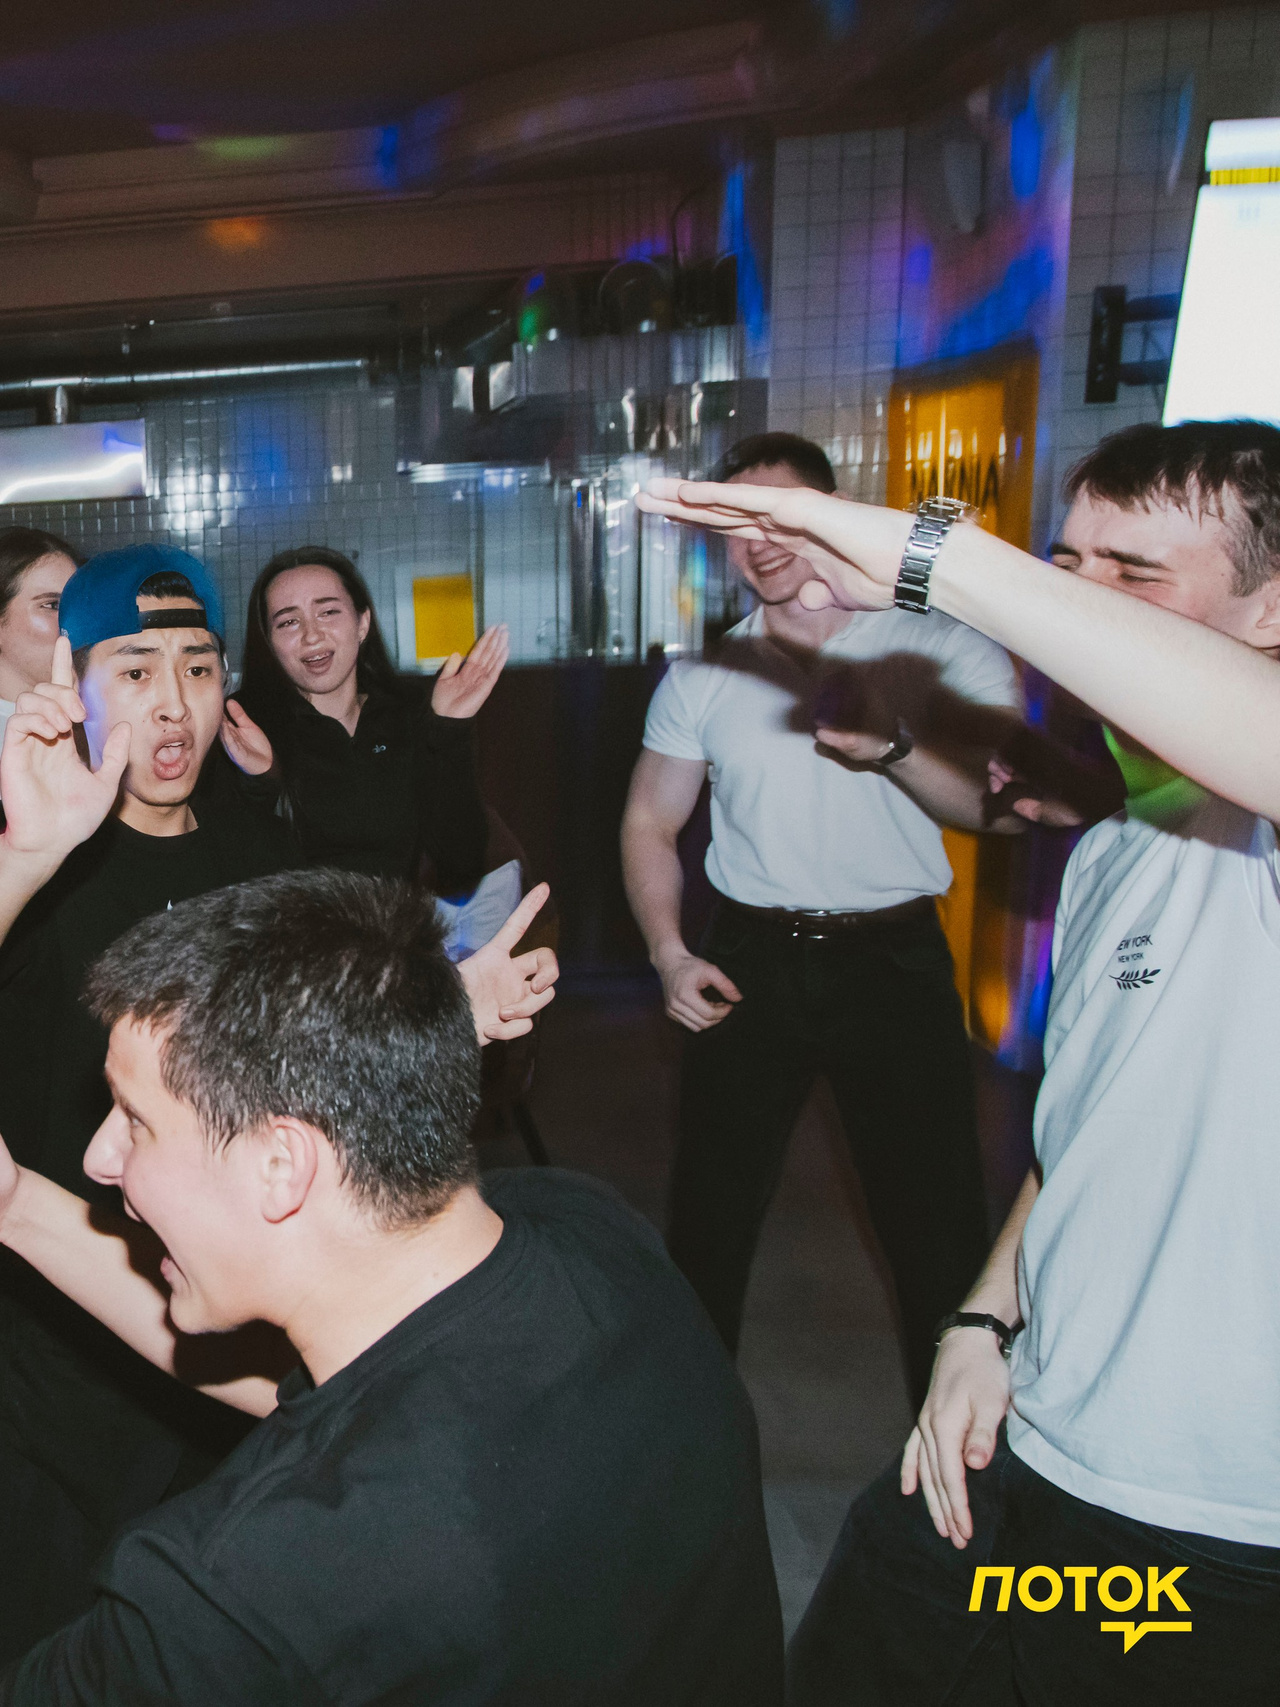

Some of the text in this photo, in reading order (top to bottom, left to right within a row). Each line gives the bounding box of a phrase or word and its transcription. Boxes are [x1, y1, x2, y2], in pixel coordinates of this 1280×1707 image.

[1116, 934, 1154, 951] EW YORK
[1117, 952, 1144, 963] NEW YORK
